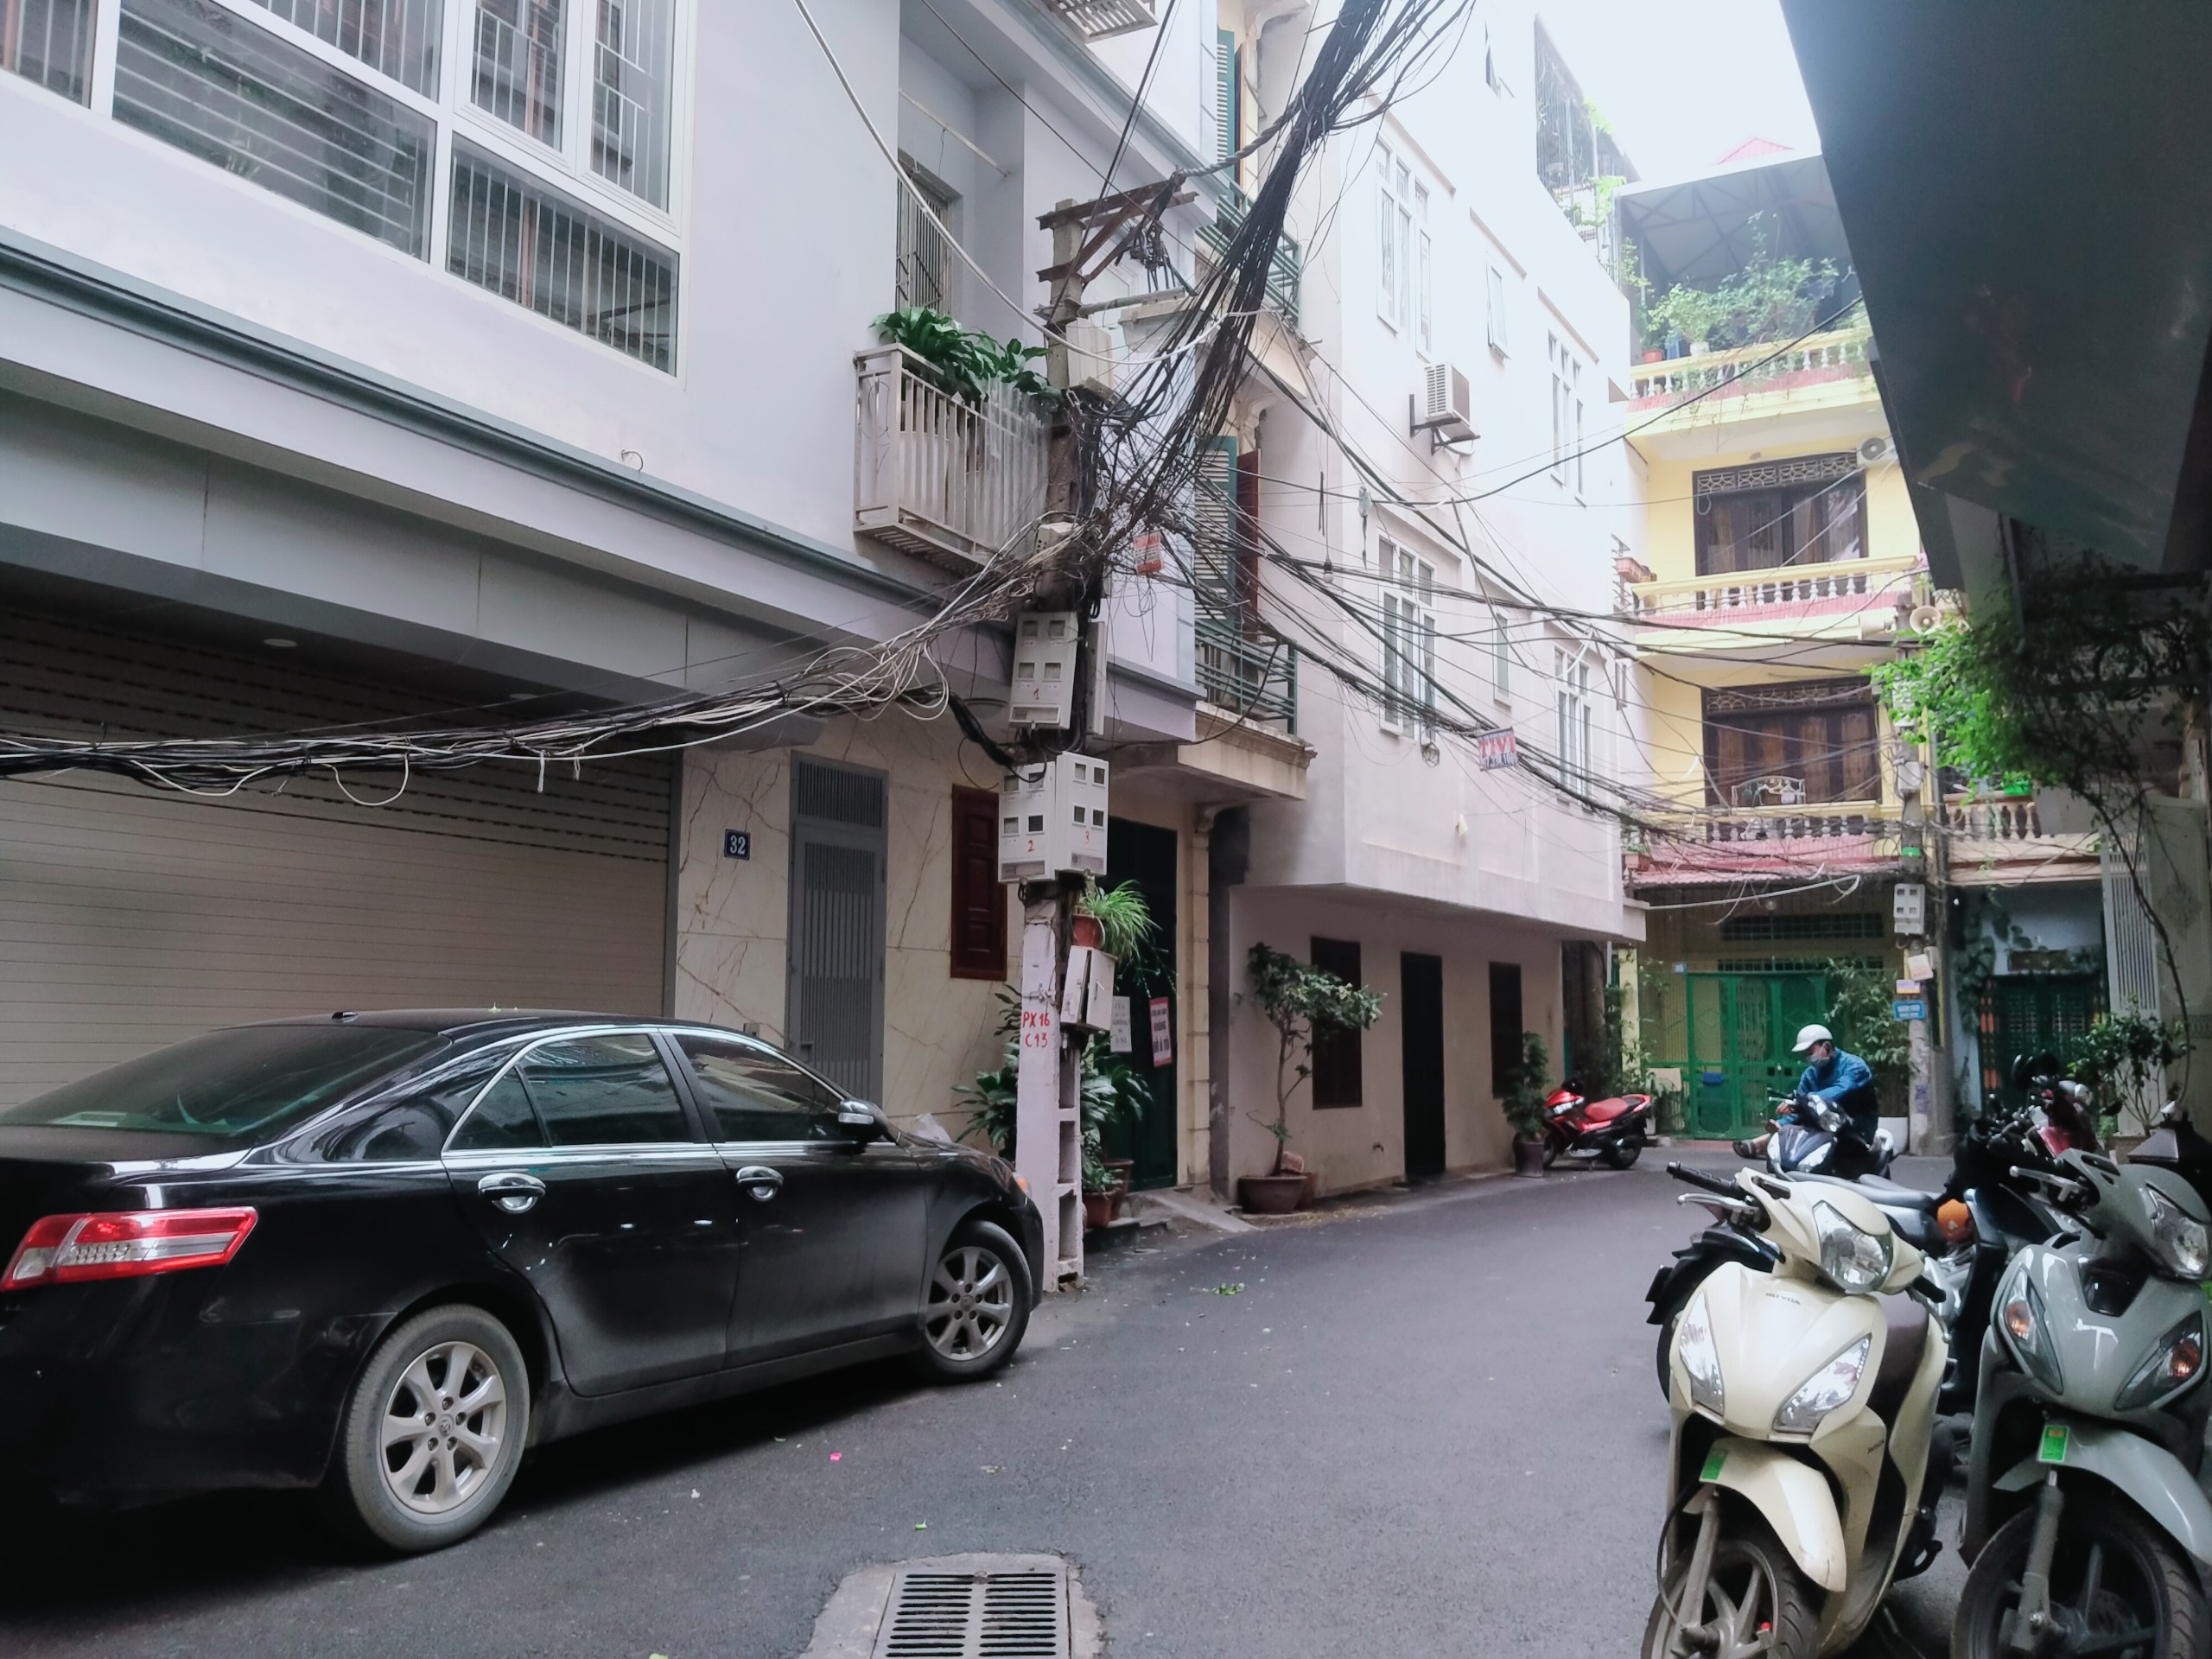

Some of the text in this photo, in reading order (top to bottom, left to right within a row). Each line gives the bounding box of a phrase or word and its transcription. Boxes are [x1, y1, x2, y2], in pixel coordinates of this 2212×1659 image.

[1033, 688, 1039, 700] 1
[1479, 736, 1515, 759] TIVI
[730, 836, 746, 854] 32
[1027, 839, 1035, 852] 2
[1022, 1011, 1050, 1027] PX 16
